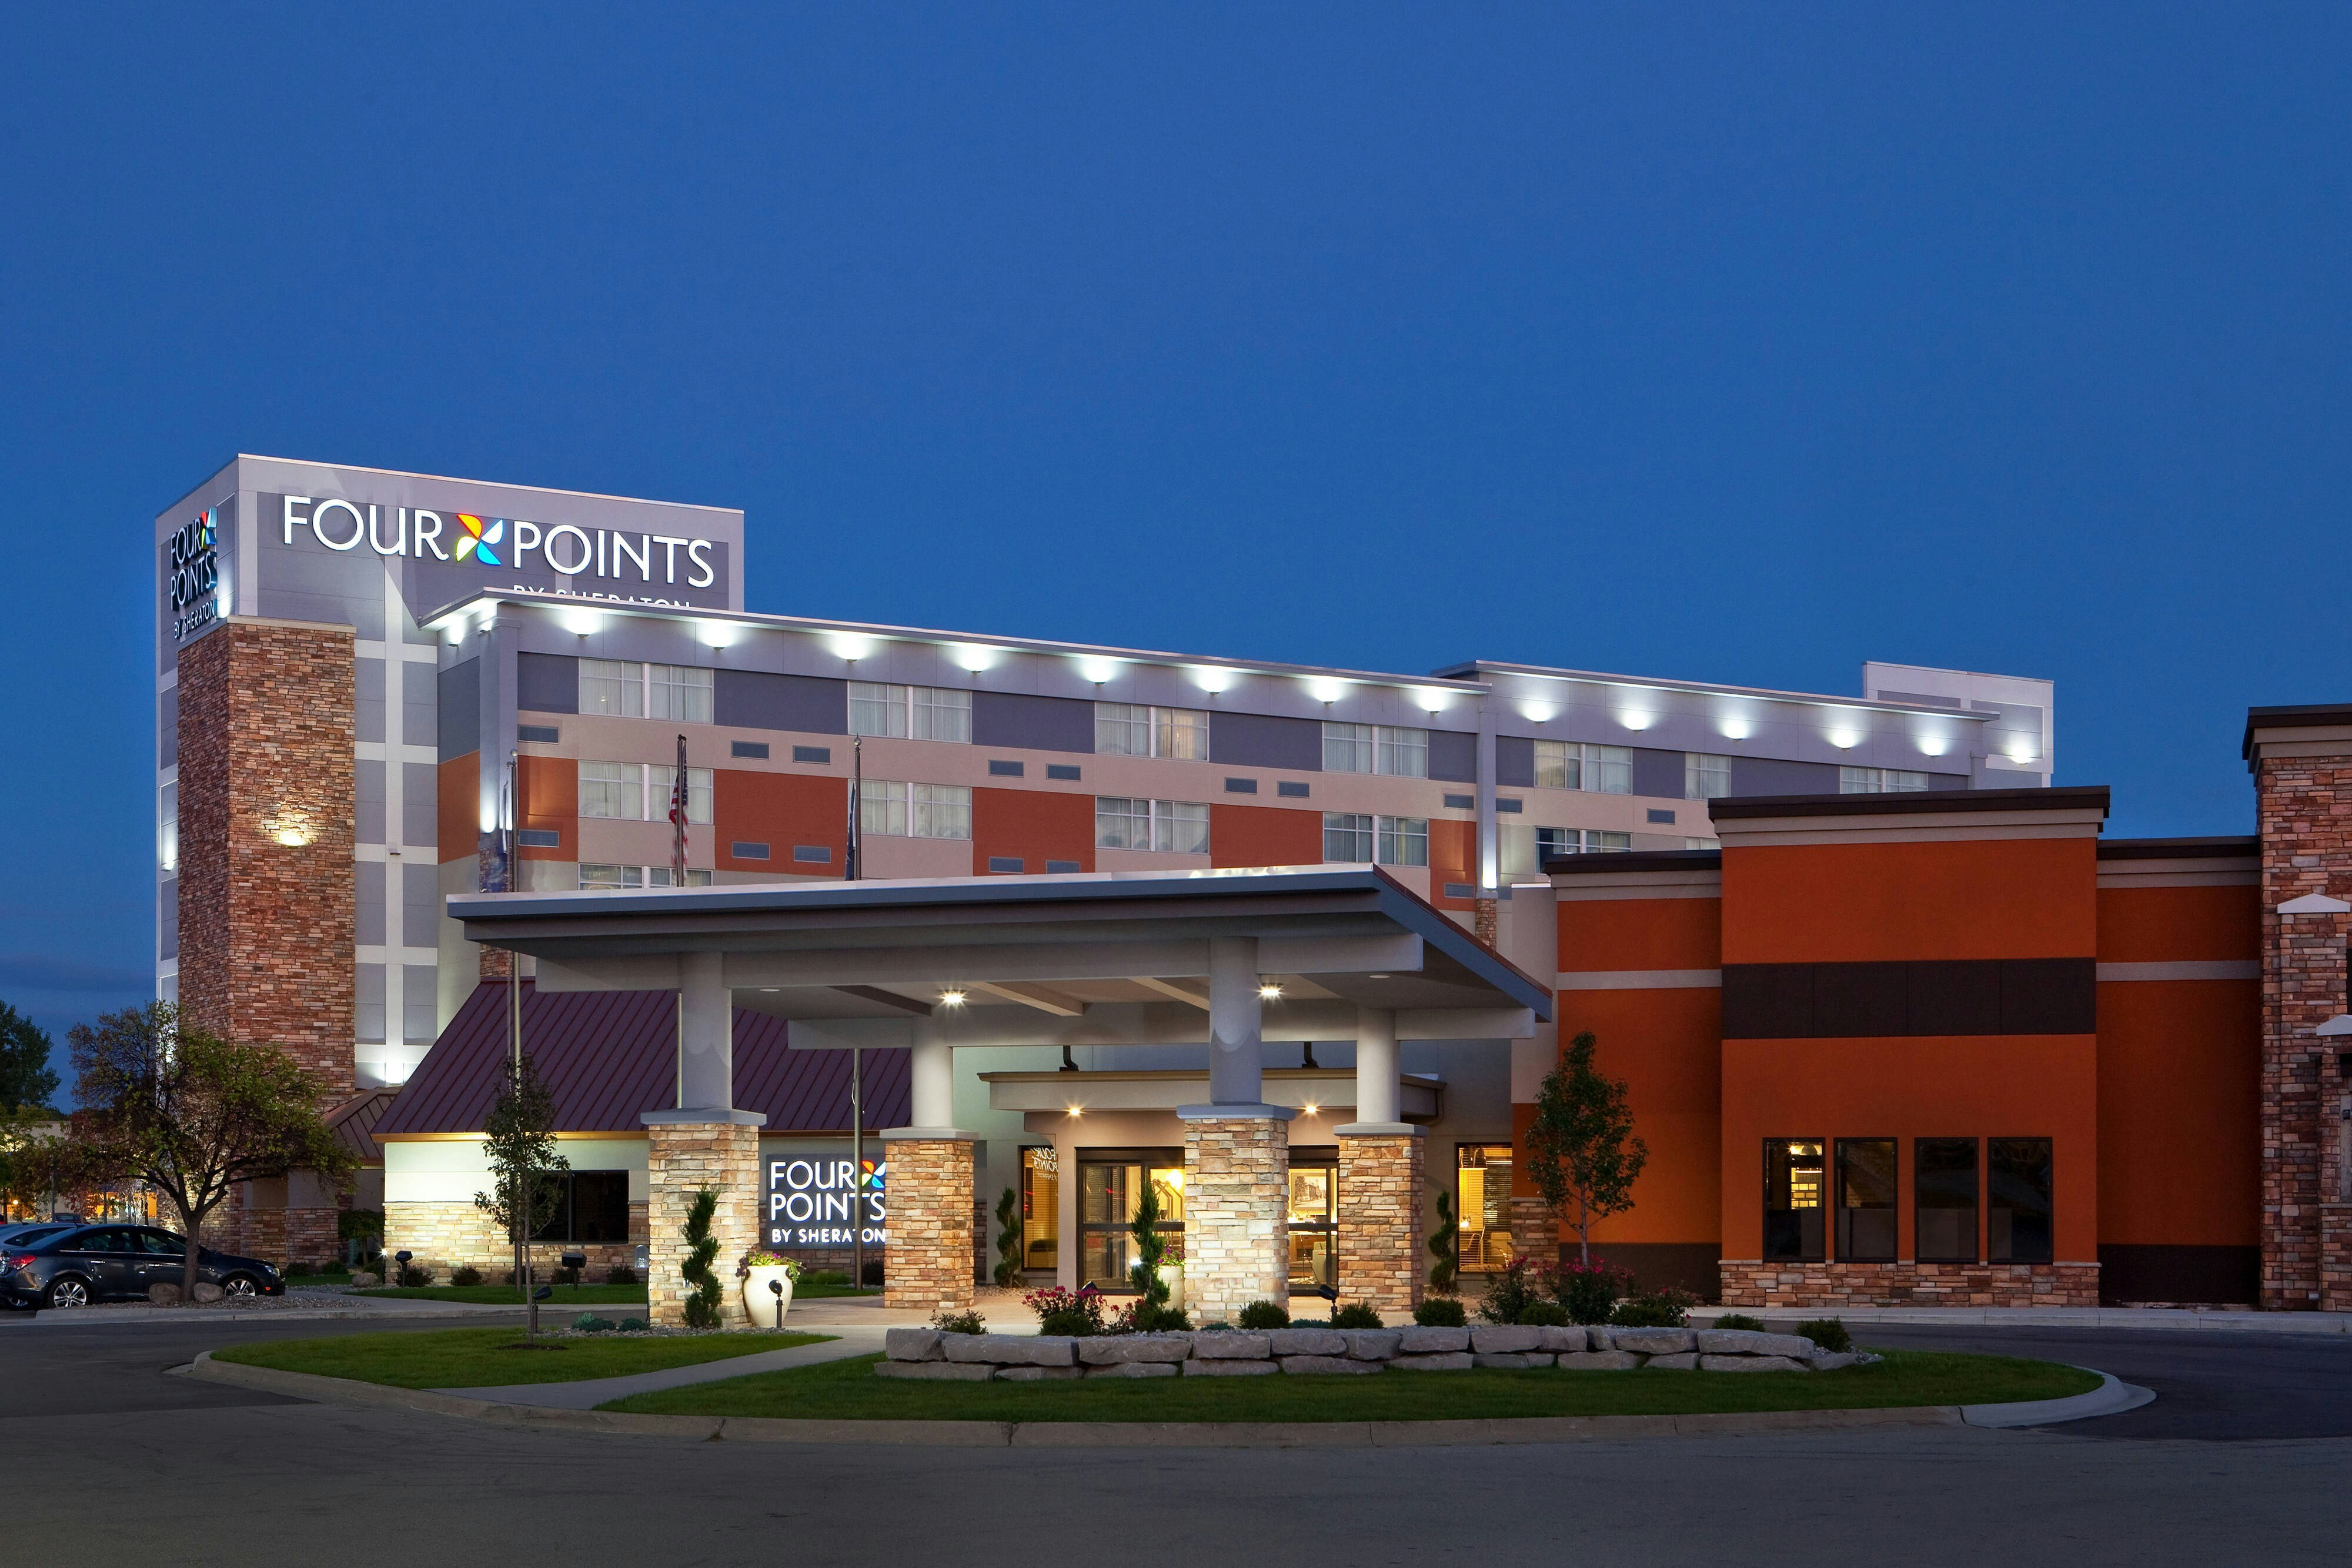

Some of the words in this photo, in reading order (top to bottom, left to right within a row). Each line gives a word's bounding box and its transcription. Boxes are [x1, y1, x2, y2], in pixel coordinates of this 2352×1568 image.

[171, 517, 202, 570] FOUR
[283, 494, 449, 561] FOUR
[513, 521, 715, 588] POINTS
[171, 550, 213, 611] POINTS
[174, 619, 181, 640] BY
[183, 600, 215, 634] SHERATON
[770, 1160, 856, 1190] FOUR
[771, 1228, 793, 1243] BY
[798, 1228, 886, 1243] SHERAON
